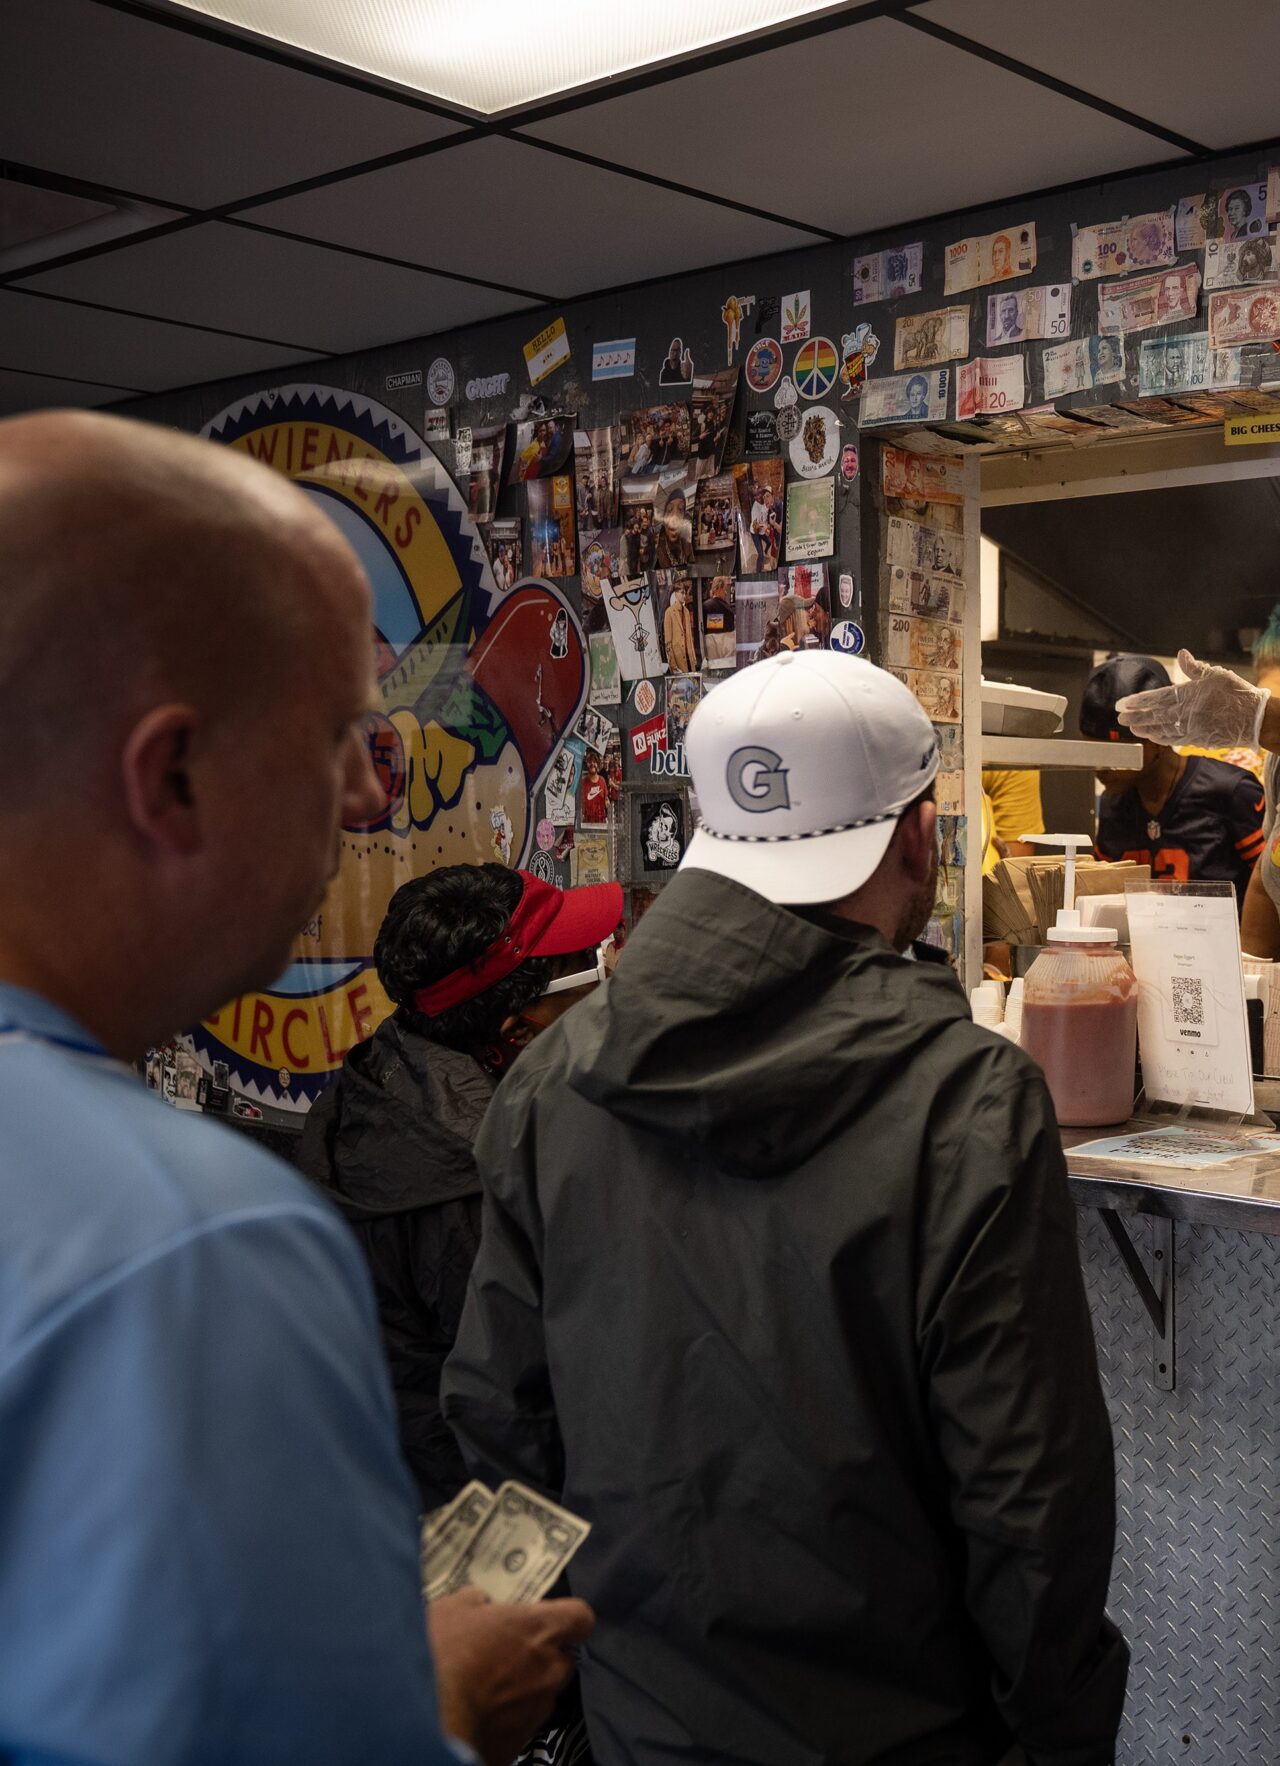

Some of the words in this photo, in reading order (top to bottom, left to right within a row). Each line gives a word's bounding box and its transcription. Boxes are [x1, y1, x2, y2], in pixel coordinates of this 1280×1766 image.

[1258, 186, 1267, 201] 5
[1097, 242, 1117, 257] 100
[1051, 320, 1066, 335] 50
[532, 325, 557, 350] HELLO
[389, 373, 421, 388] CHAPMAN
[990, 391, 1007, 409] 20
[1231, 426, 1248, 436] BIG
[247, 426, 421, 548] WIENERS
[892, 618, 910, 632] 200
[726, 745, 791, 814] G
[1180, 1029, 1201, 1038] venmo
